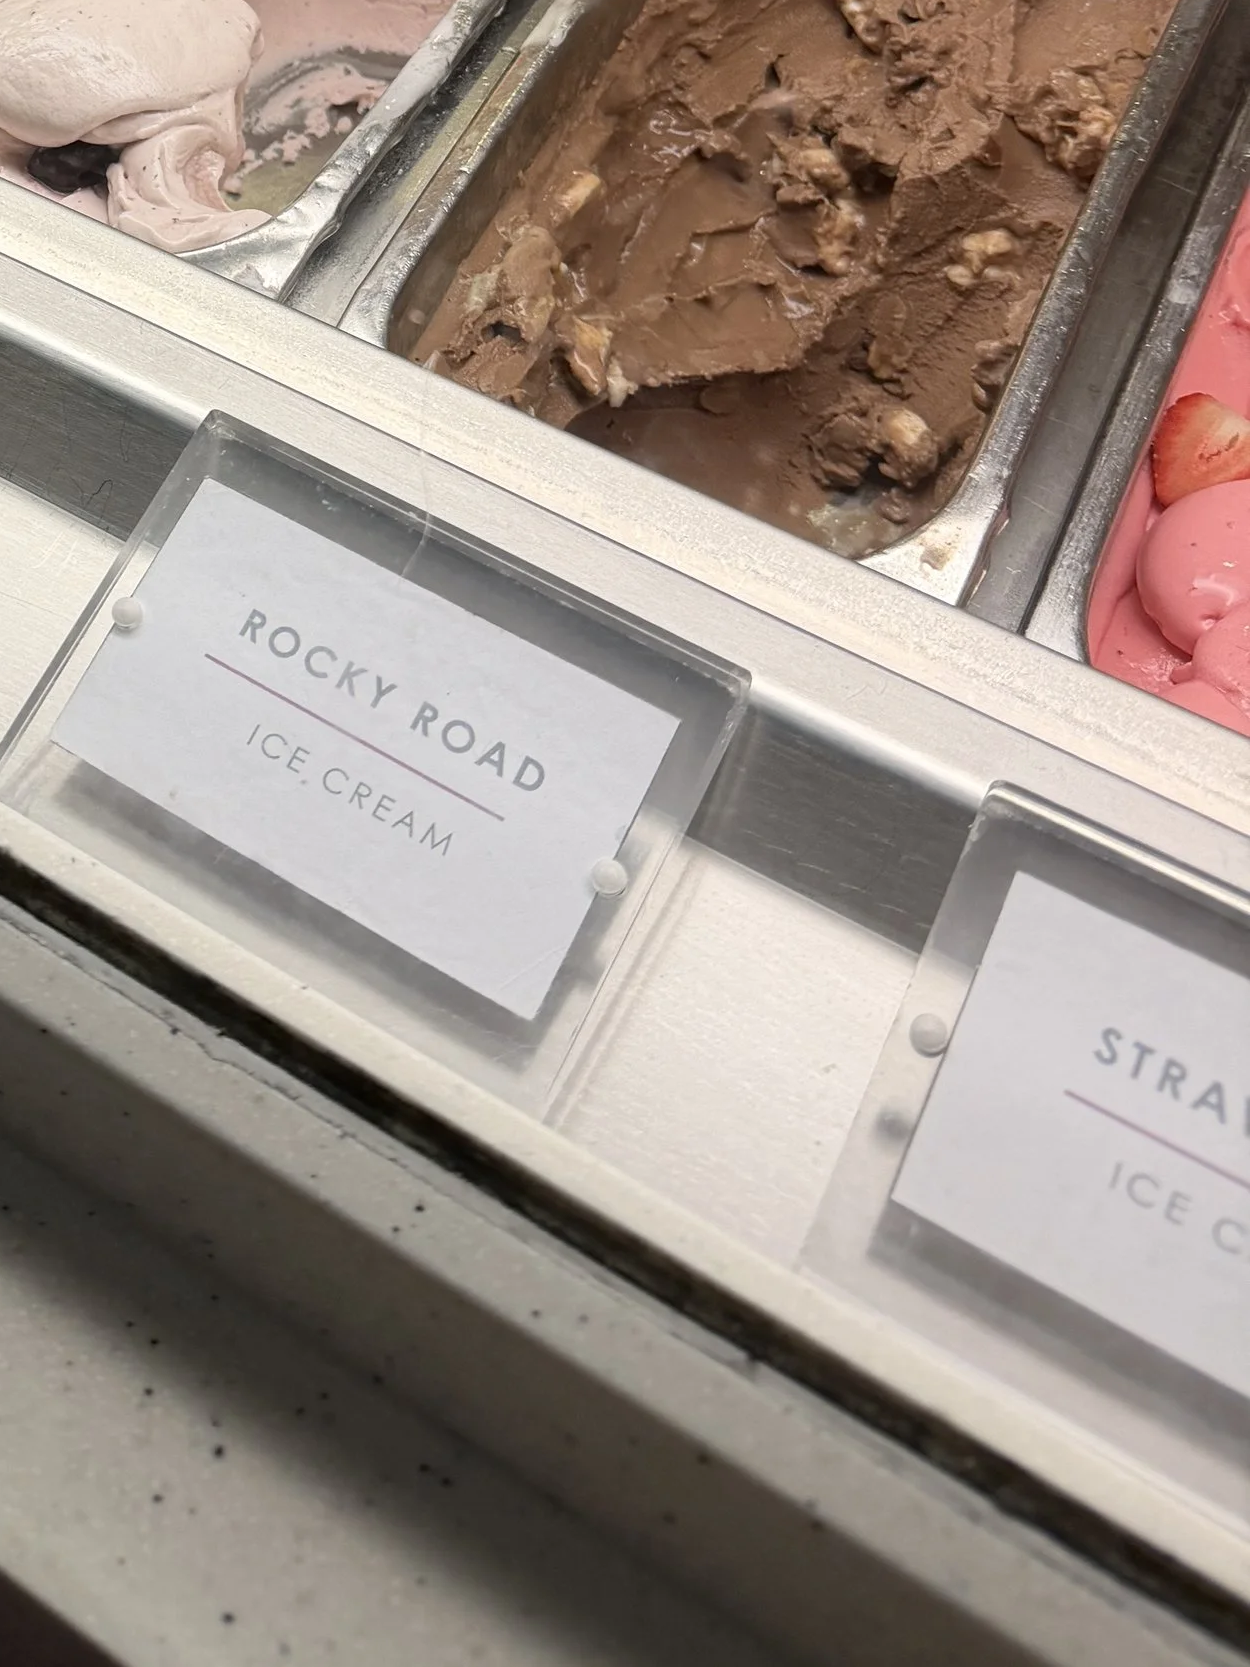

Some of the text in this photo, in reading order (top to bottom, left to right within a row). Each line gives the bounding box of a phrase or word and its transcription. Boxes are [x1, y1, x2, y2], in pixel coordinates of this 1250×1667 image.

[239, 608, 545, 791] ROCKY ROAD
[246, 724, 453, 856] ICE CREAM
[1094, 1027, 1250, 1137] STRA
[1108, 1161, 1192, 1226] ICE
